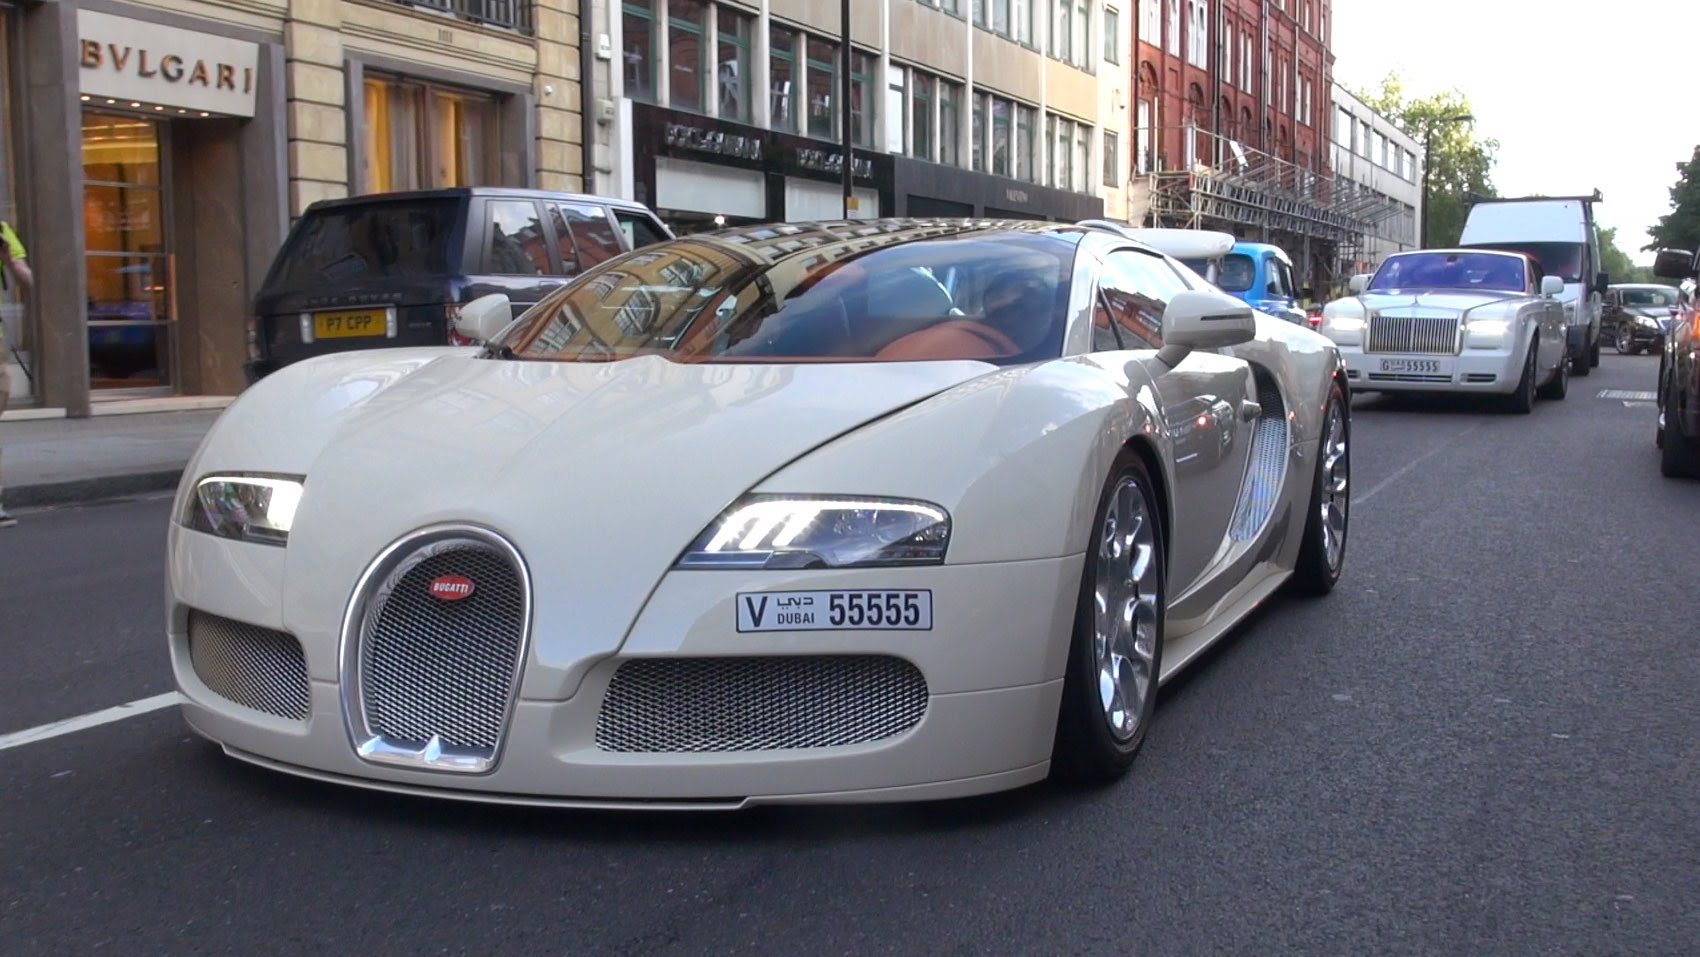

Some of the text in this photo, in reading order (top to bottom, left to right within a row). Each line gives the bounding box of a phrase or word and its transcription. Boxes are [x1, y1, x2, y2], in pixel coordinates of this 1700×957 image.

[80, 38, 254, 94] BVLGARI
[325, 315, 373, 331] P7 CPP
[1382, 359, 1390, 371] G
[1406, 360, 1439, 372] 55555
[433, 582, 470, 593] BUGATTI
[745, 593, 920, 628] V 55555
[777, 613, 815, 625] DUBAI
